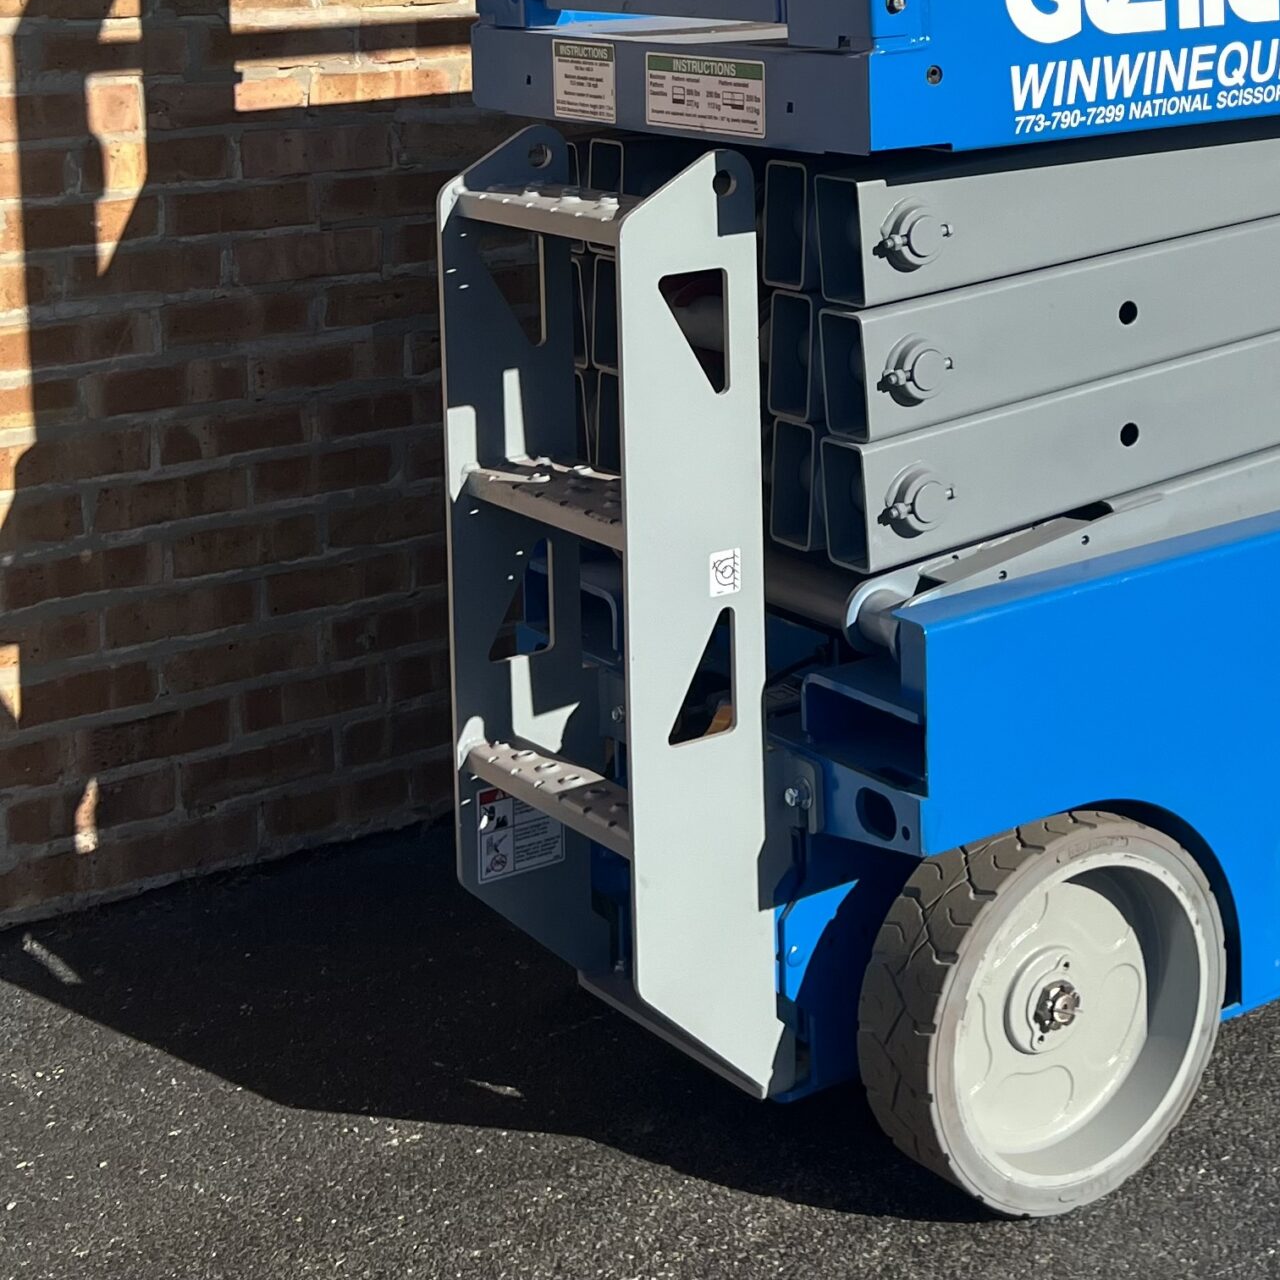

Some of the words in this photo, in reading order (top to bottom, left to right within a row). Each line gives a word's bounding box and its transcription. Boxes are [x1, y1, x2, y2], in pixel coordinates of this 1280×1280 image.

[560, 45, 608, 59] INSTRUCTIONS
[672, 59, 736, 76] INSTRUCTIONS
[1015, 103, 1124, 135] 773-790-7299
[1128, 93, 1212, 120] NATIONAL
